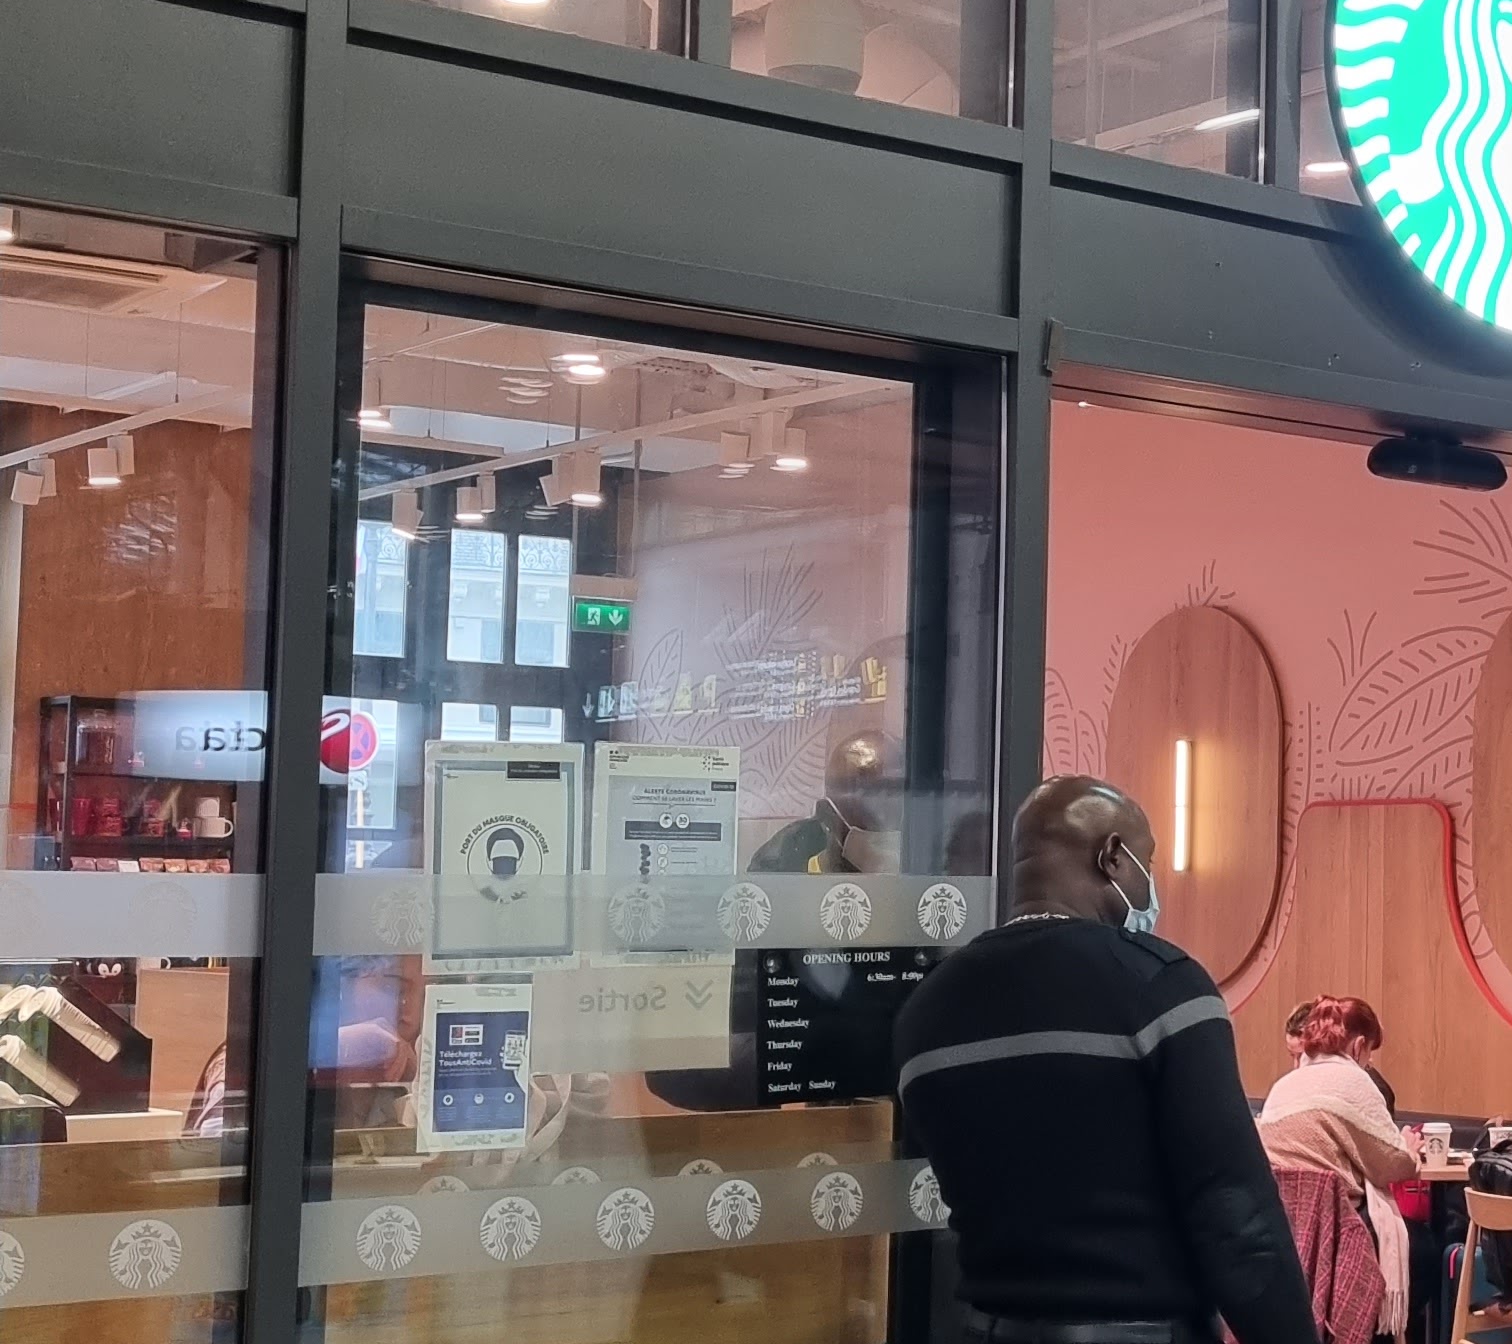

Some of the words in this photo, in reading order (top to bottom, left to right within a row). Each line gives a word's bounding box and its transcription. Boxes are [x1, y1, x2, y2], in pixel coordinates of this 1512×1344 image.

[482, 815, 514, 828] MASQUE
[803, 952, 852, 965] OPENING
[854, 951, 890, 963] HOURS
[768, 976, 799, 987] Monday
[768, 997, 798, 1008] Tuesday
[768, 1018, 810, 1029] Wednesday
[767, 1040, 803, 1050] Thursday
[767, 1061, 793, 1072] Friday
[768, 1081, 801, 1093] Saturday
[809, 1079, 836, 1090] Sunday
